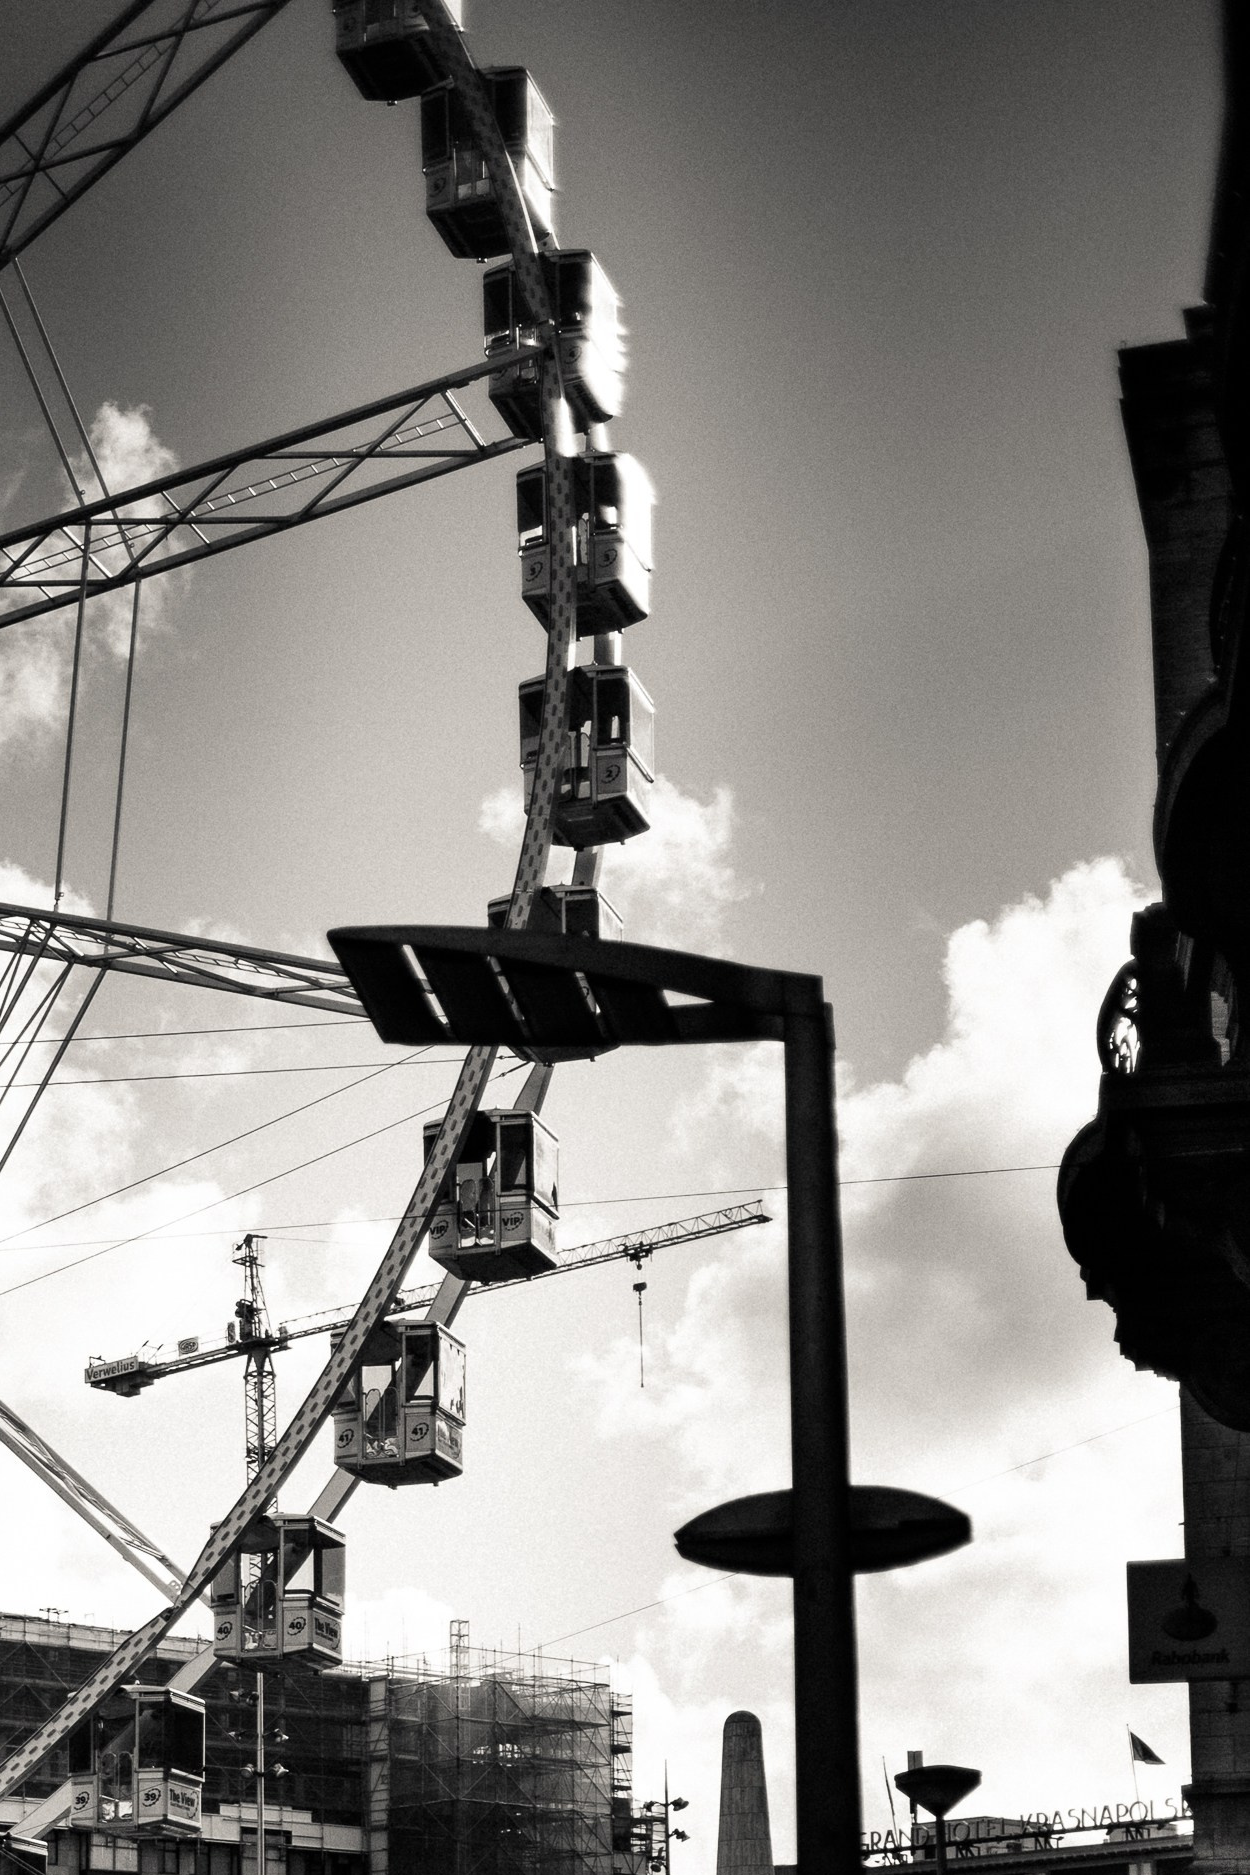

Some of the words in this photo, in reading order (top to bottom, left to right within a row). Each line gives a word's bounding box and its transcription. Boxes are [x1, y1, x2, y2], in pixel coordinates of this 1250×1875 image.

[502, 1217, 520, 1227] VIP
[430, 1225, 445, 1235] VIP
[412, 1427, 423, 1435] 41
[289, 1621, 302, 1630] 40
[217, 1626, 229, 1635] 40
[1152, 1649, 1230, 1665] Rabobank
[144, 1792, 156, 1801] 39
[170, 1788, 180, 1802] The
[75, 1796, 86, 1804] 39
